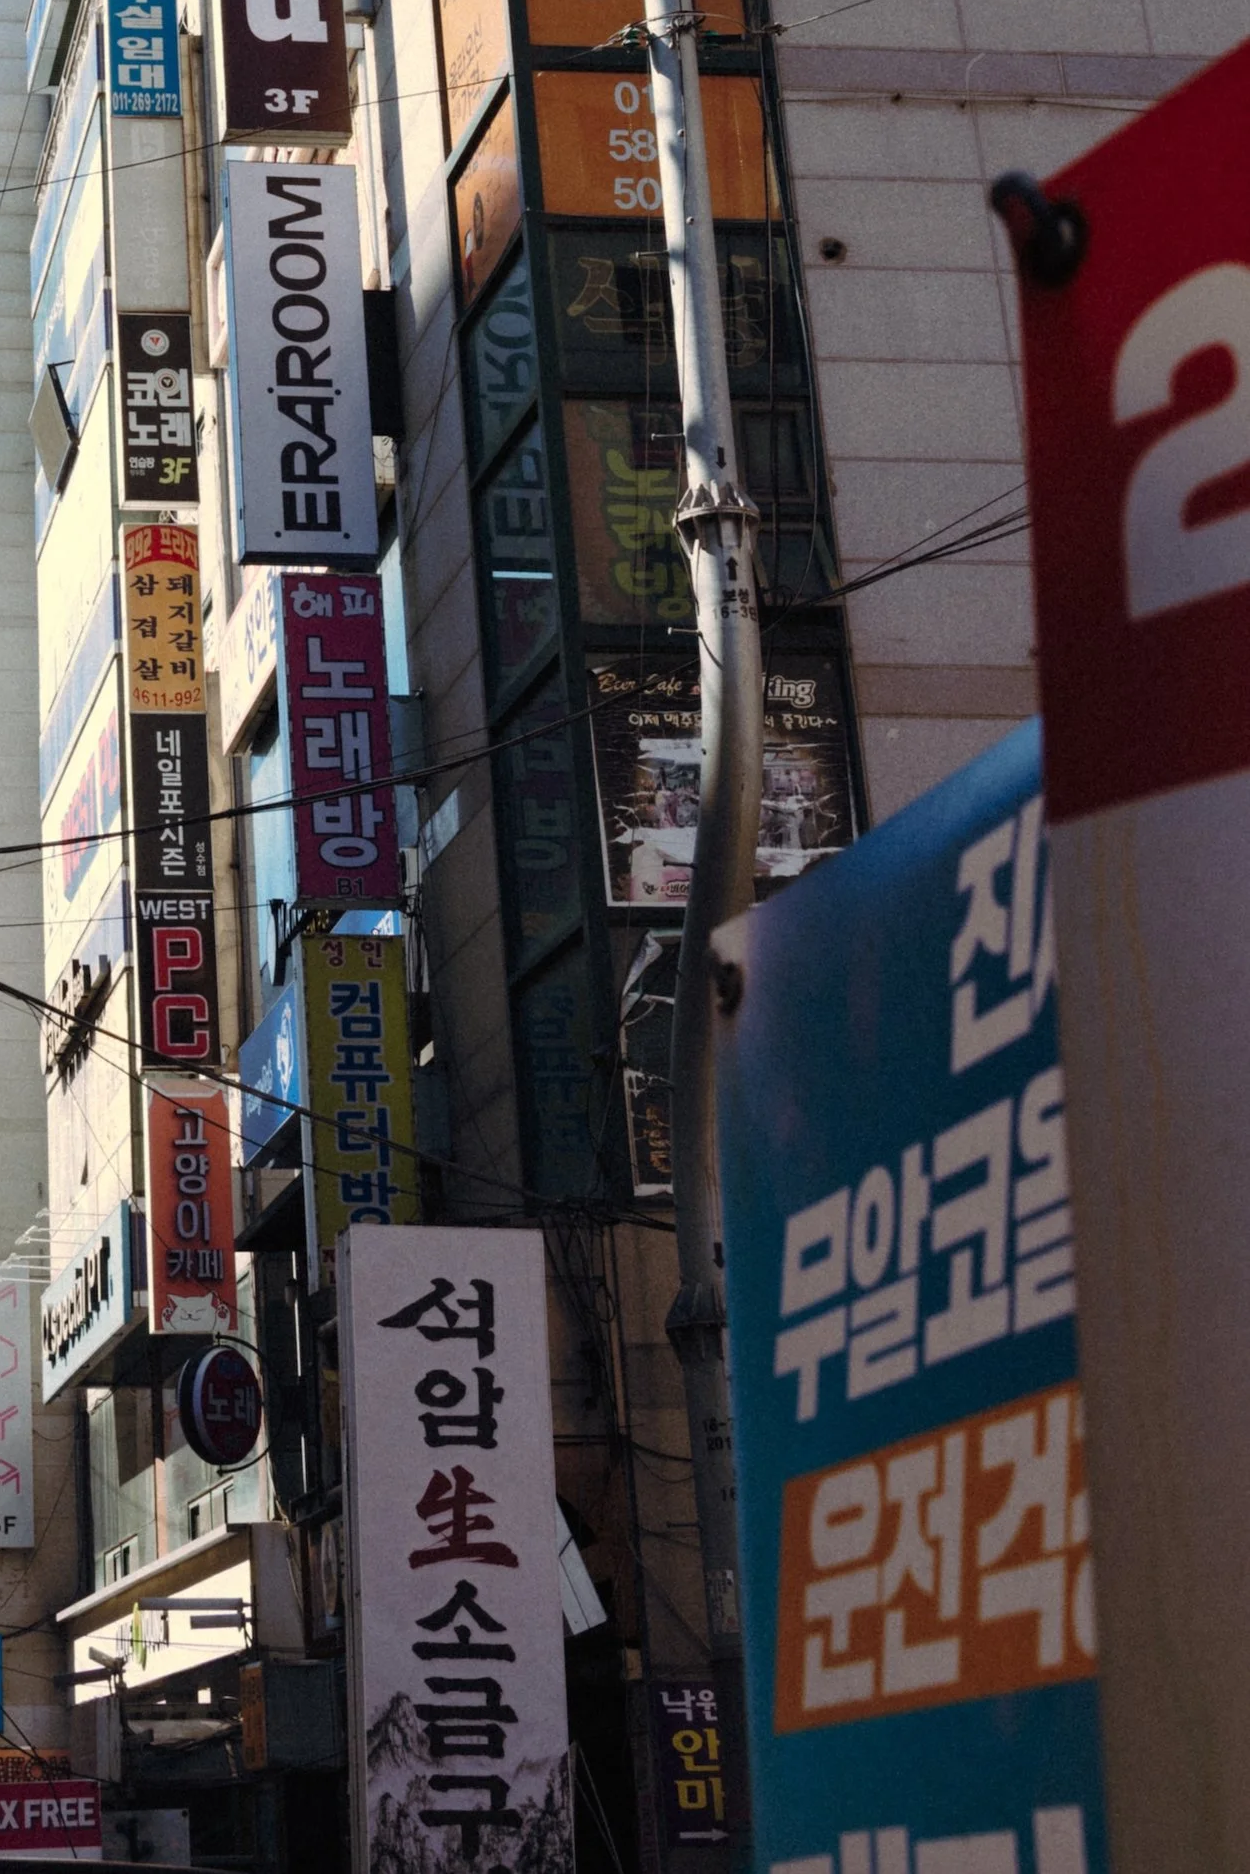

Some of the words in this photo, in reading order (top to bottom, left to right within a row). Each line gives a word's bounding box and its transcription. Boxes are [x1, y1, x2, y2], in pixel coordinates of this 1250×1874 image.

[116, 36, 166, 90] 임대
[112, 91, 179, 114] 011-269-2172
[264, 87, 319, 115] 3F
[613, 80, 655, 115] 01
[126, 367, 191, 408] 코인
[127, 410, 193, 448] 노래
[128, 456, 155, 470] 연습장
[158, 457, 192, 485] 3F
[126, 532, 152, 567] 992
[160, 527, 199, 567] 프라자
[129, 573, 163, 682] 삼겹살
[165, 573, 199, 682] 돼지갈비
[762, 674, 816, 709] king
[302, 636, 385, 869] 노래방
[194, 840, 206, 877] 성수점
[335, 876, 366, 897] B1
[138, 899, 211, 920] WEST
[321, 939, 383, 968] 성인
[950, 796, 1058, 1074] 진
[152, 926, 210, 1059] PC
[329, 981, 398, 1225] 컴퓨터방
[173, 1107, 211, 1242] 고양이
[166, 1248, 224, 1281] 카페
[205, 1381, 258, 1431] 노래
[377, 1277, 522, 1874] 석암生소금구
[803, 1431, 965, 1713] 운전
[659, 1689, 718, 1722] 낙원
[672, 1727, 727, 1822] 안마
[23, 1796, 96, 1830] FREE
